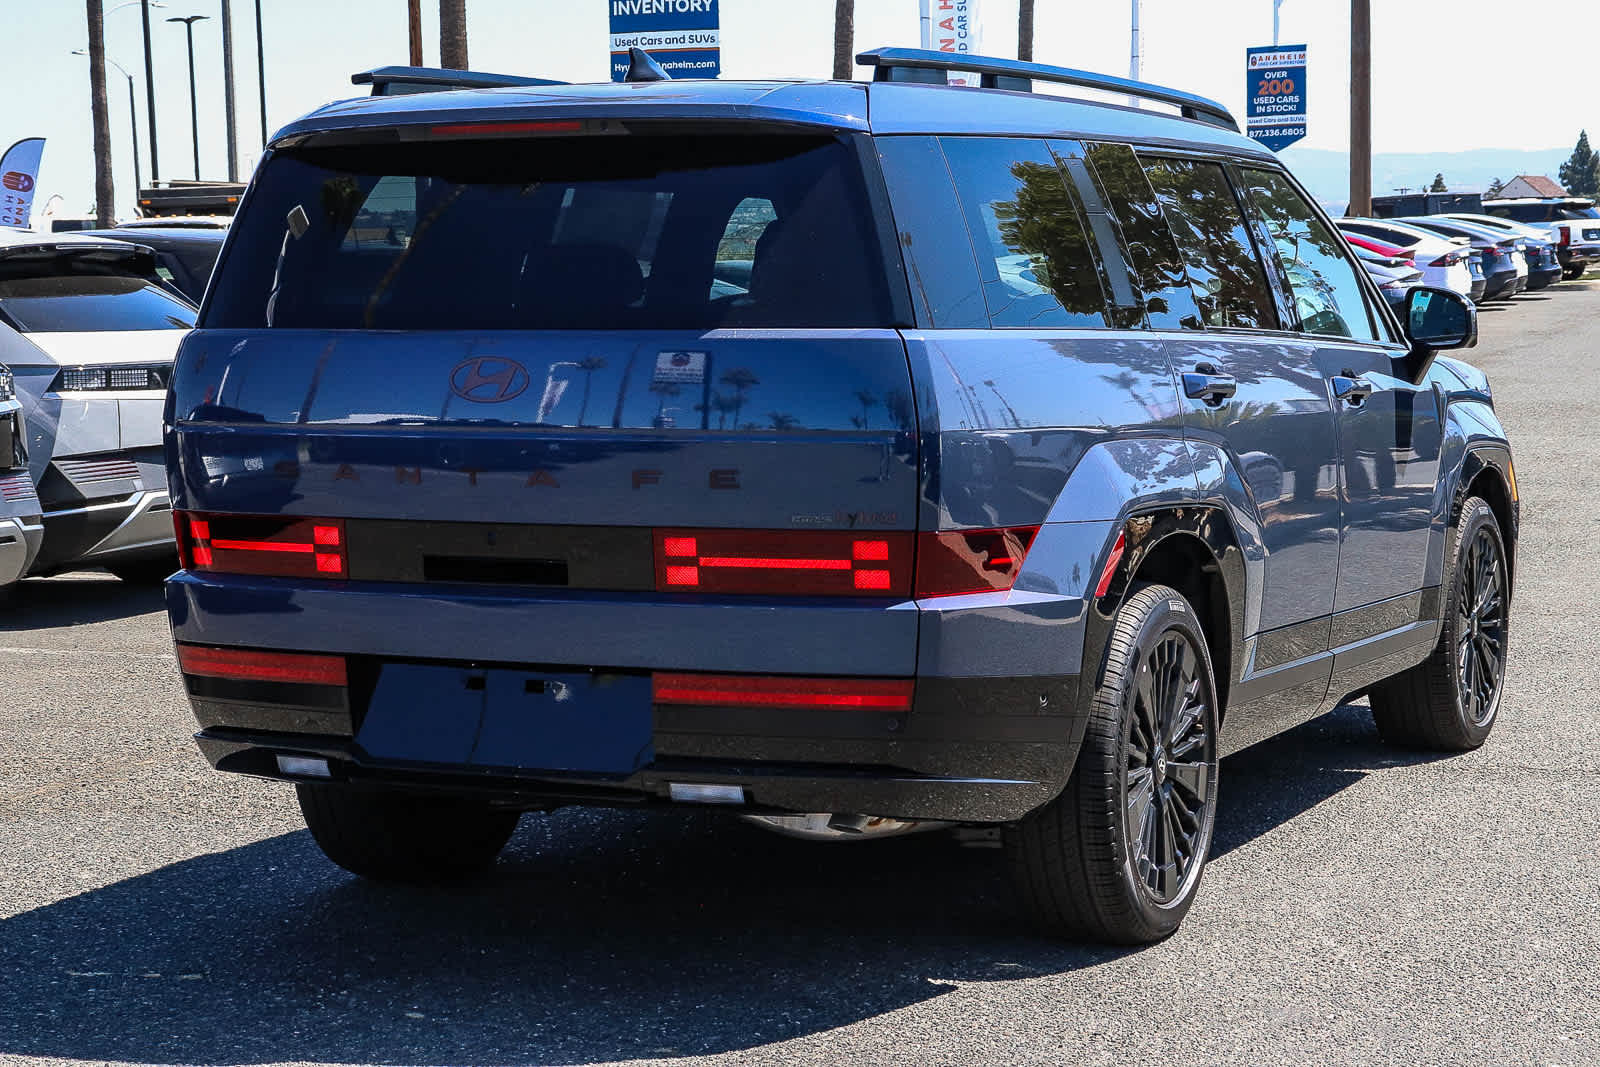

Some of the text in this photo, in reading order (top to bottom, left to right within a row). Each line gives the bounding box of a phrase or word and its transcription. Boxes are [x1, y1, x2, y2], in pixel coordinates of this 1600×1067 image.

[613, 0, 713, 16] INVENTORY
[958, 15, 968, 39] CAR
[614, 34, 716, 47] Used Cars and SUVs
[1258, 53, 1305, 62] ANAHEIM
[1264, 70, 1288, 79] OVER
[1258, 79, 1294, 95] 200
[1253, 95, 1300, 104] USED CARS
[1256, 104, 1296, 113] IN STOCK!
[1248, 128, 1305, 138] 877.336.6805
[273, 460, 741, 490] SANTA FE
